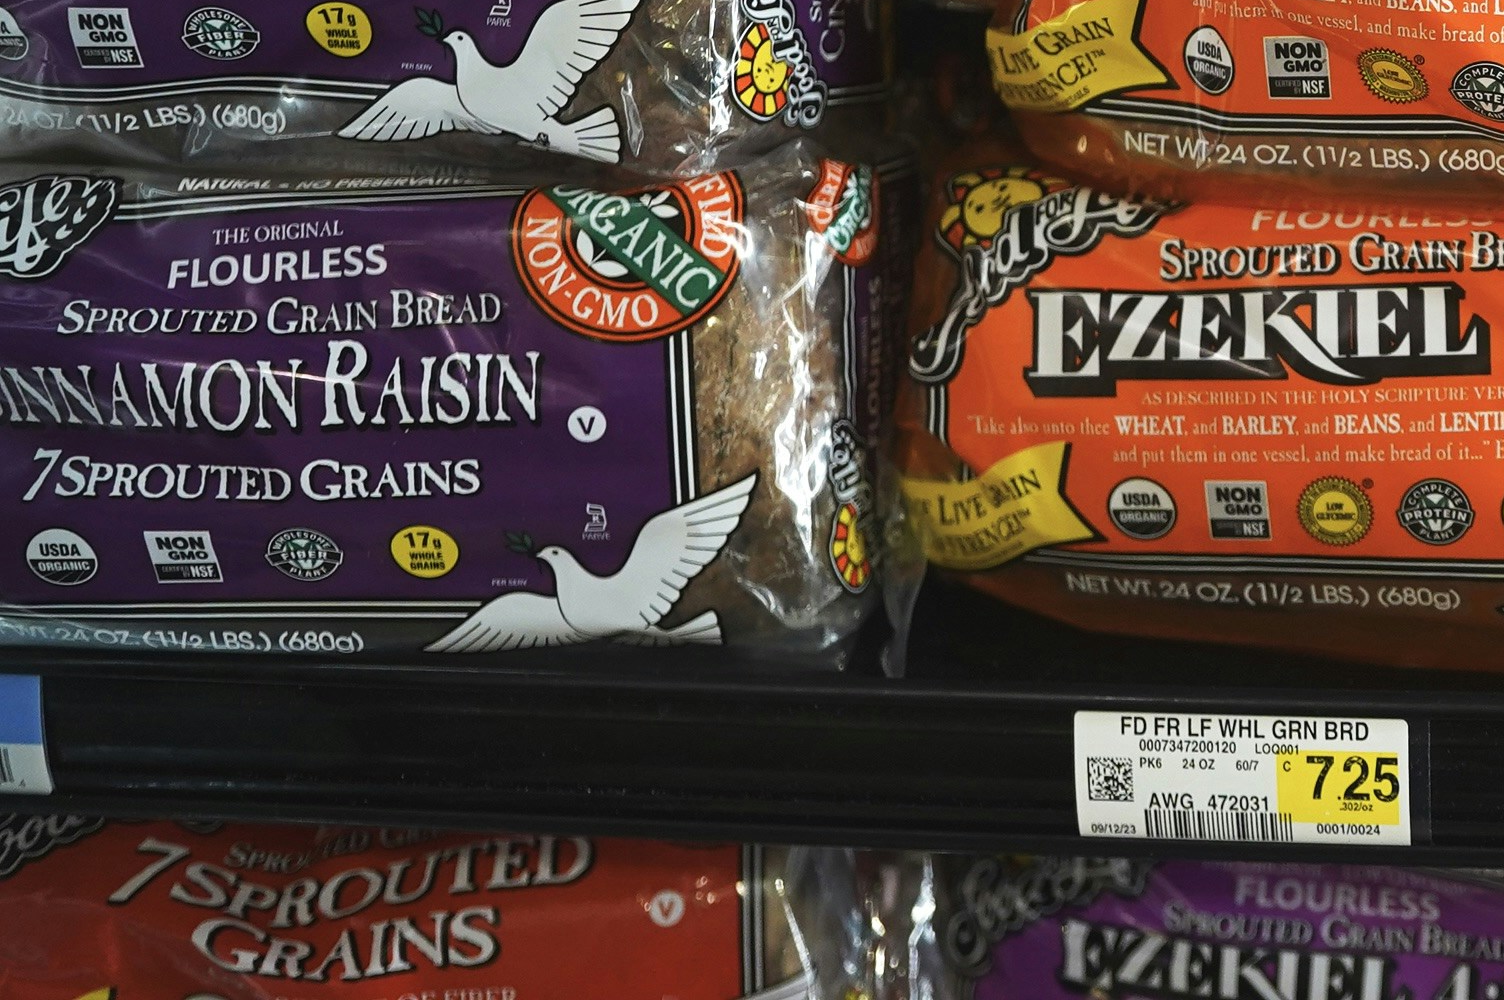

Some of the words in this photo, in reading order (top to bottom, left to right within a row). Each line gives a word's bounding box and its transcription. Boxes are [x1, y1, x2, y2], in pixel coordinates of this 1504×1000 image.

[77, 12, 125, 31] NON
[324, 28, 359, 40] WHOLE
[1315, 13, 1363, 34] vessel,
[1366, 19, 1394, 37] and
[1396, 22, 1437, 41] make
[1441, 26, 1486, 45] bread
[88, 28, 128, 44] GMO
[326, 39, 361, 51] GRAINS
[1274, 41, 1322, 60] NON
[1283, 58, 1323, 74] GMO
[212, 103, 288, 135] (680g)
[1124, 130, 1169, 158] NET
[1217, 143, 1247, 165] 24
[1251, 145, 1298, 167] OZ.
[1370, 147, 1430, 173] LBS.)
[212, 228, 250, 245] THE
[253, 219, 344, 244] ORIGINAL
[167, 243, 389, 291] FLOURLESS
[1160, 239, 1338, 281] SPROUTED
[1348, 232, 1462, 274] GRAIN
[525, 215, 661, 330] NON-GMO
[56, 299, 258, 336] SPROUTED
[266, 296, 379, 335] GRAIN
[390, 289, 501, 330] BREAD
[1029, 286, 1479, 380] EZEKIEL
[320, 339, 541, 427] RAISIN
[1114, 414, 1188, 437] WHEAT,
[1221, 414, 1300, 438] BARLEY,
[1333, 413, 1404, 435] BEANS,
[299, 457, 482, 502] GRAINS
[38, 543, 82, 559] USDA
[37, 560, 91, 573] ORGANIC
[1378, 586, 1462, 612] (680g)
[278, 631, 365, 654] (680g)
[1119, 716, 1147, 736] FD
[1154, 717, 1181, 737] FR
[1187, 718, 1212, 738] LF
[1219, 719, 1265, 739] WHL
[1272, 720, 1318, 741] GRN
[1325, 721, 1370, 742] BRD
[1138, 739, 1237, 755] 0007347200120
[1139, 758, 1163, 770] PK6
[1181, 758, 1197, 771] 24
[1198, 759, 1216, 771] OZ
[1235, 760, 1259, 772] 60/7
[1282, 761, 1292, 773] C
[1305, 755, 1401, 804] 7.25
[1148, 793, 1195, 810] AWG
[1207, 795, 1270, 812] 472031
[1090, 823, 1137, 836] 09/12/23
[1316, 823, 1382, 837] 0001/0024
[1234, 874, 1442, 920] FLOURLESS
[1162, 900, 1310, 946] SPROUTED
[1320, 910, 1415, 951] GRAIN
[190, 906, 501, 983] GRAINS
[1062, 918, 1390, 1000] EZEKIEL
